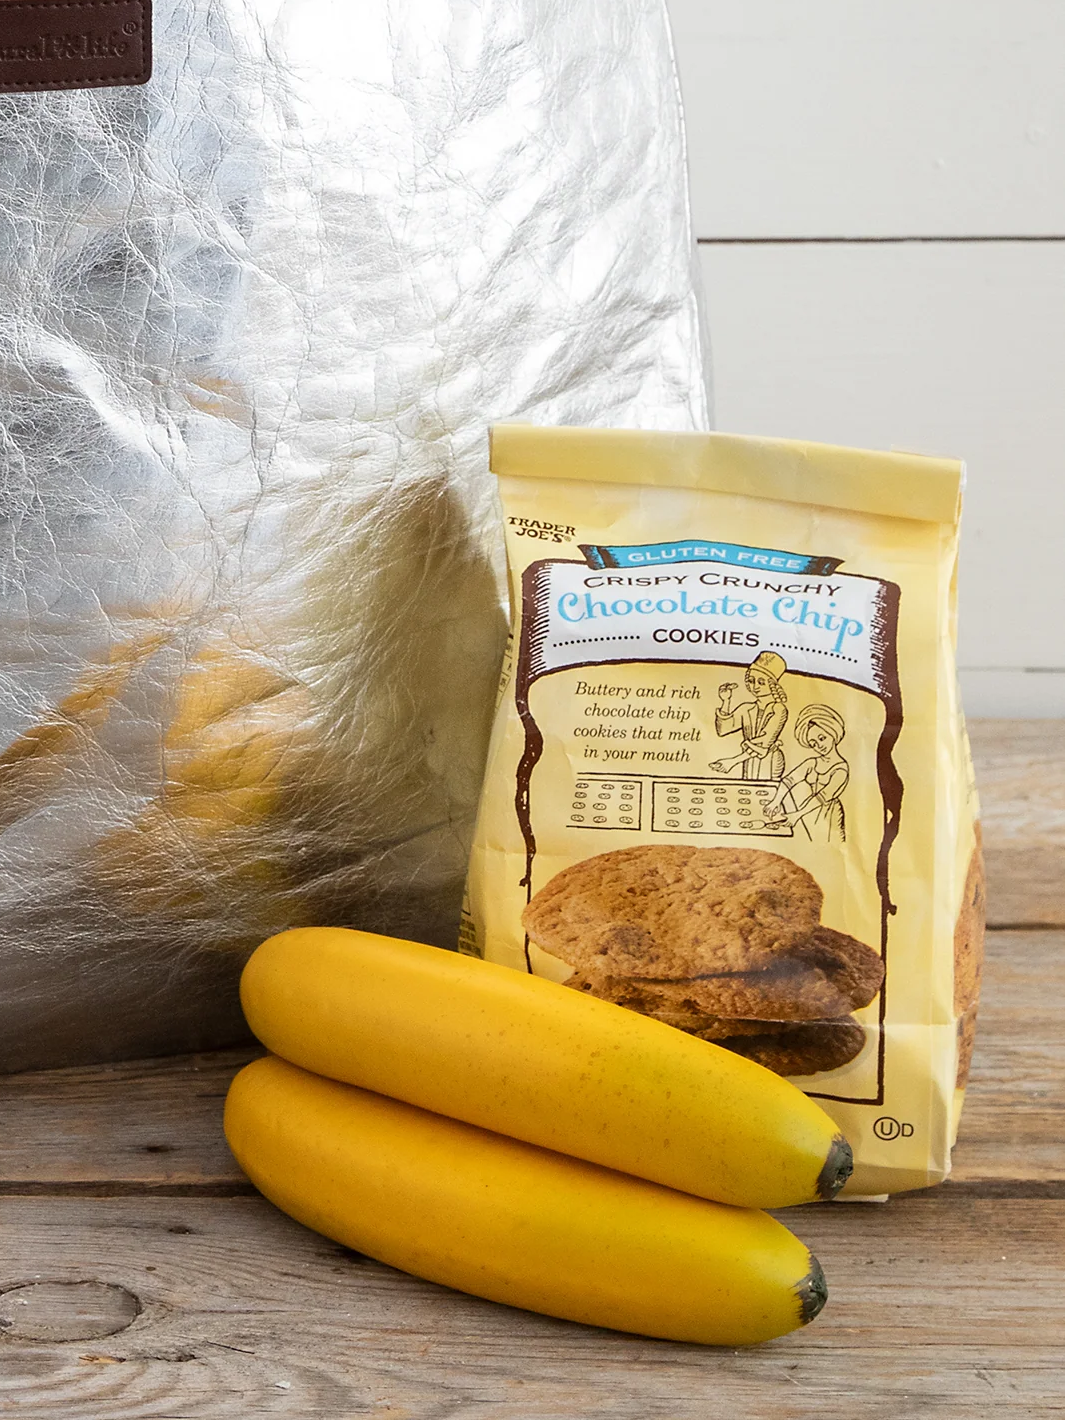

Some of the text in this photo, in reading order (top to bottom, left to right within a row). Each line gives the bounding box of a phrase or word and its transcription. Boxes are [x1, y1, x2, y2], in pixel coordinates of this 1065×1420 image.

[507, 516, 577, 537] TRADER
[515, 528, 564, 543] JOE'S
[628, 546, 802, 569] GLUTEN FREE
[583, 573, 843, 597] CRISPY CRUNCHY
[557, 591, 864, 654] Chocolate Chip
[652, 628, 760, 647] COOKIES
[575, 681, 702, 699] Buttery and rich
[584, 703, 691, 723] chocolate chip
[573, 724, 702, 742] cookies that melt
[584, 744, 691, 762] in your mouth
